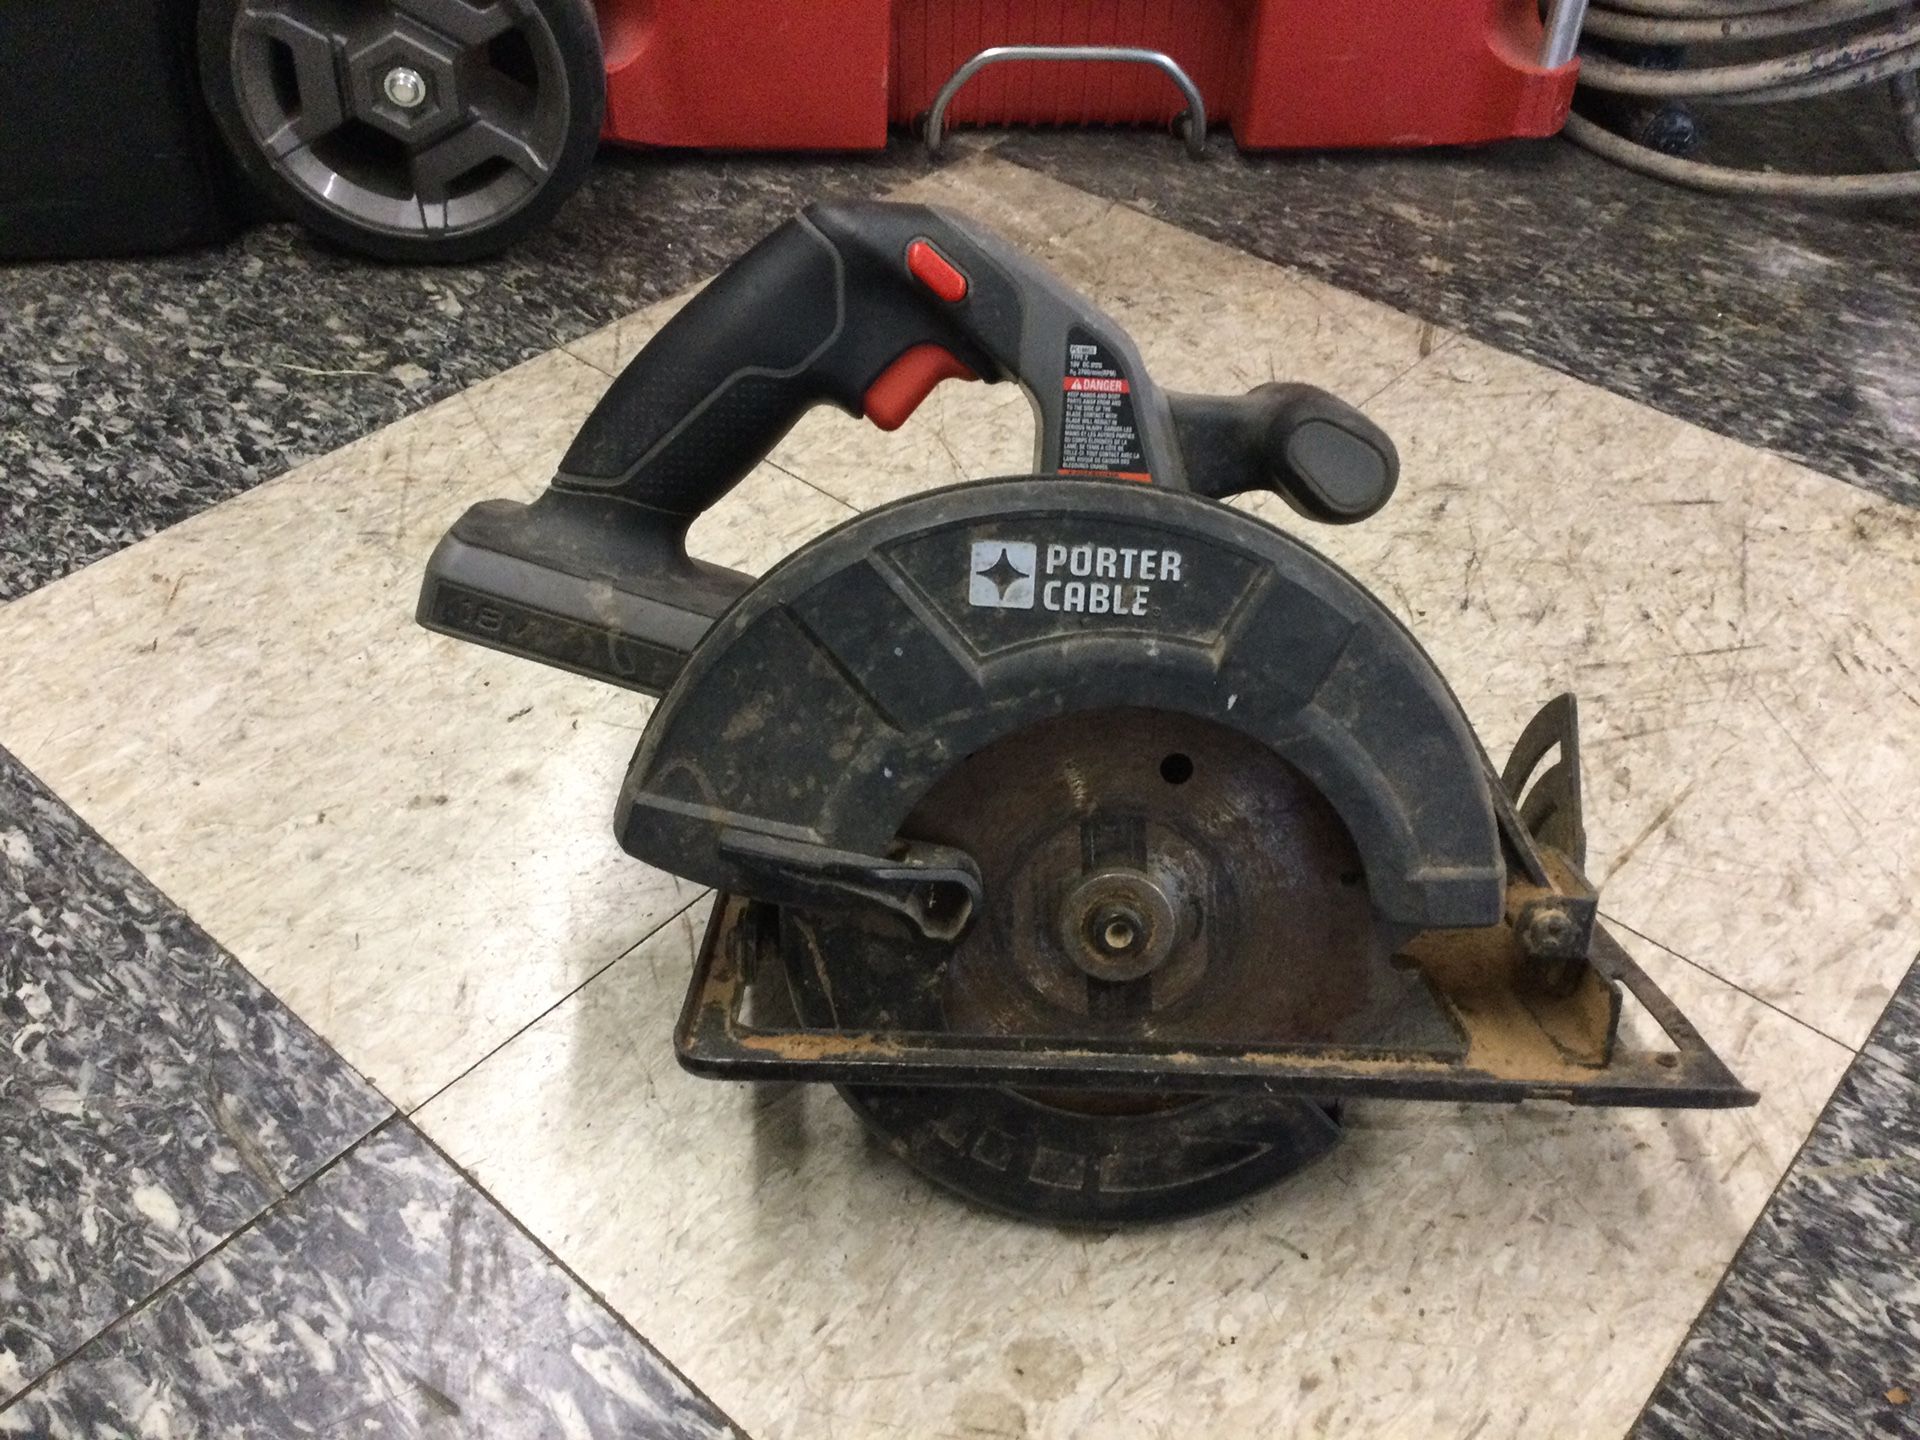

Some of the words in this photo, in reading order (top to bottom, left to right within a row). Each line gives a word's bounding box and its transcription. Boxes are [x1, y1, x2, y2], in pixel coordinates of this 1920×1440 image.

[1083, 378, 1122, 391] DANGER
[1046, 544, 1182, 582] PORTER
[1043, 580, 1150, 616] CABLE
